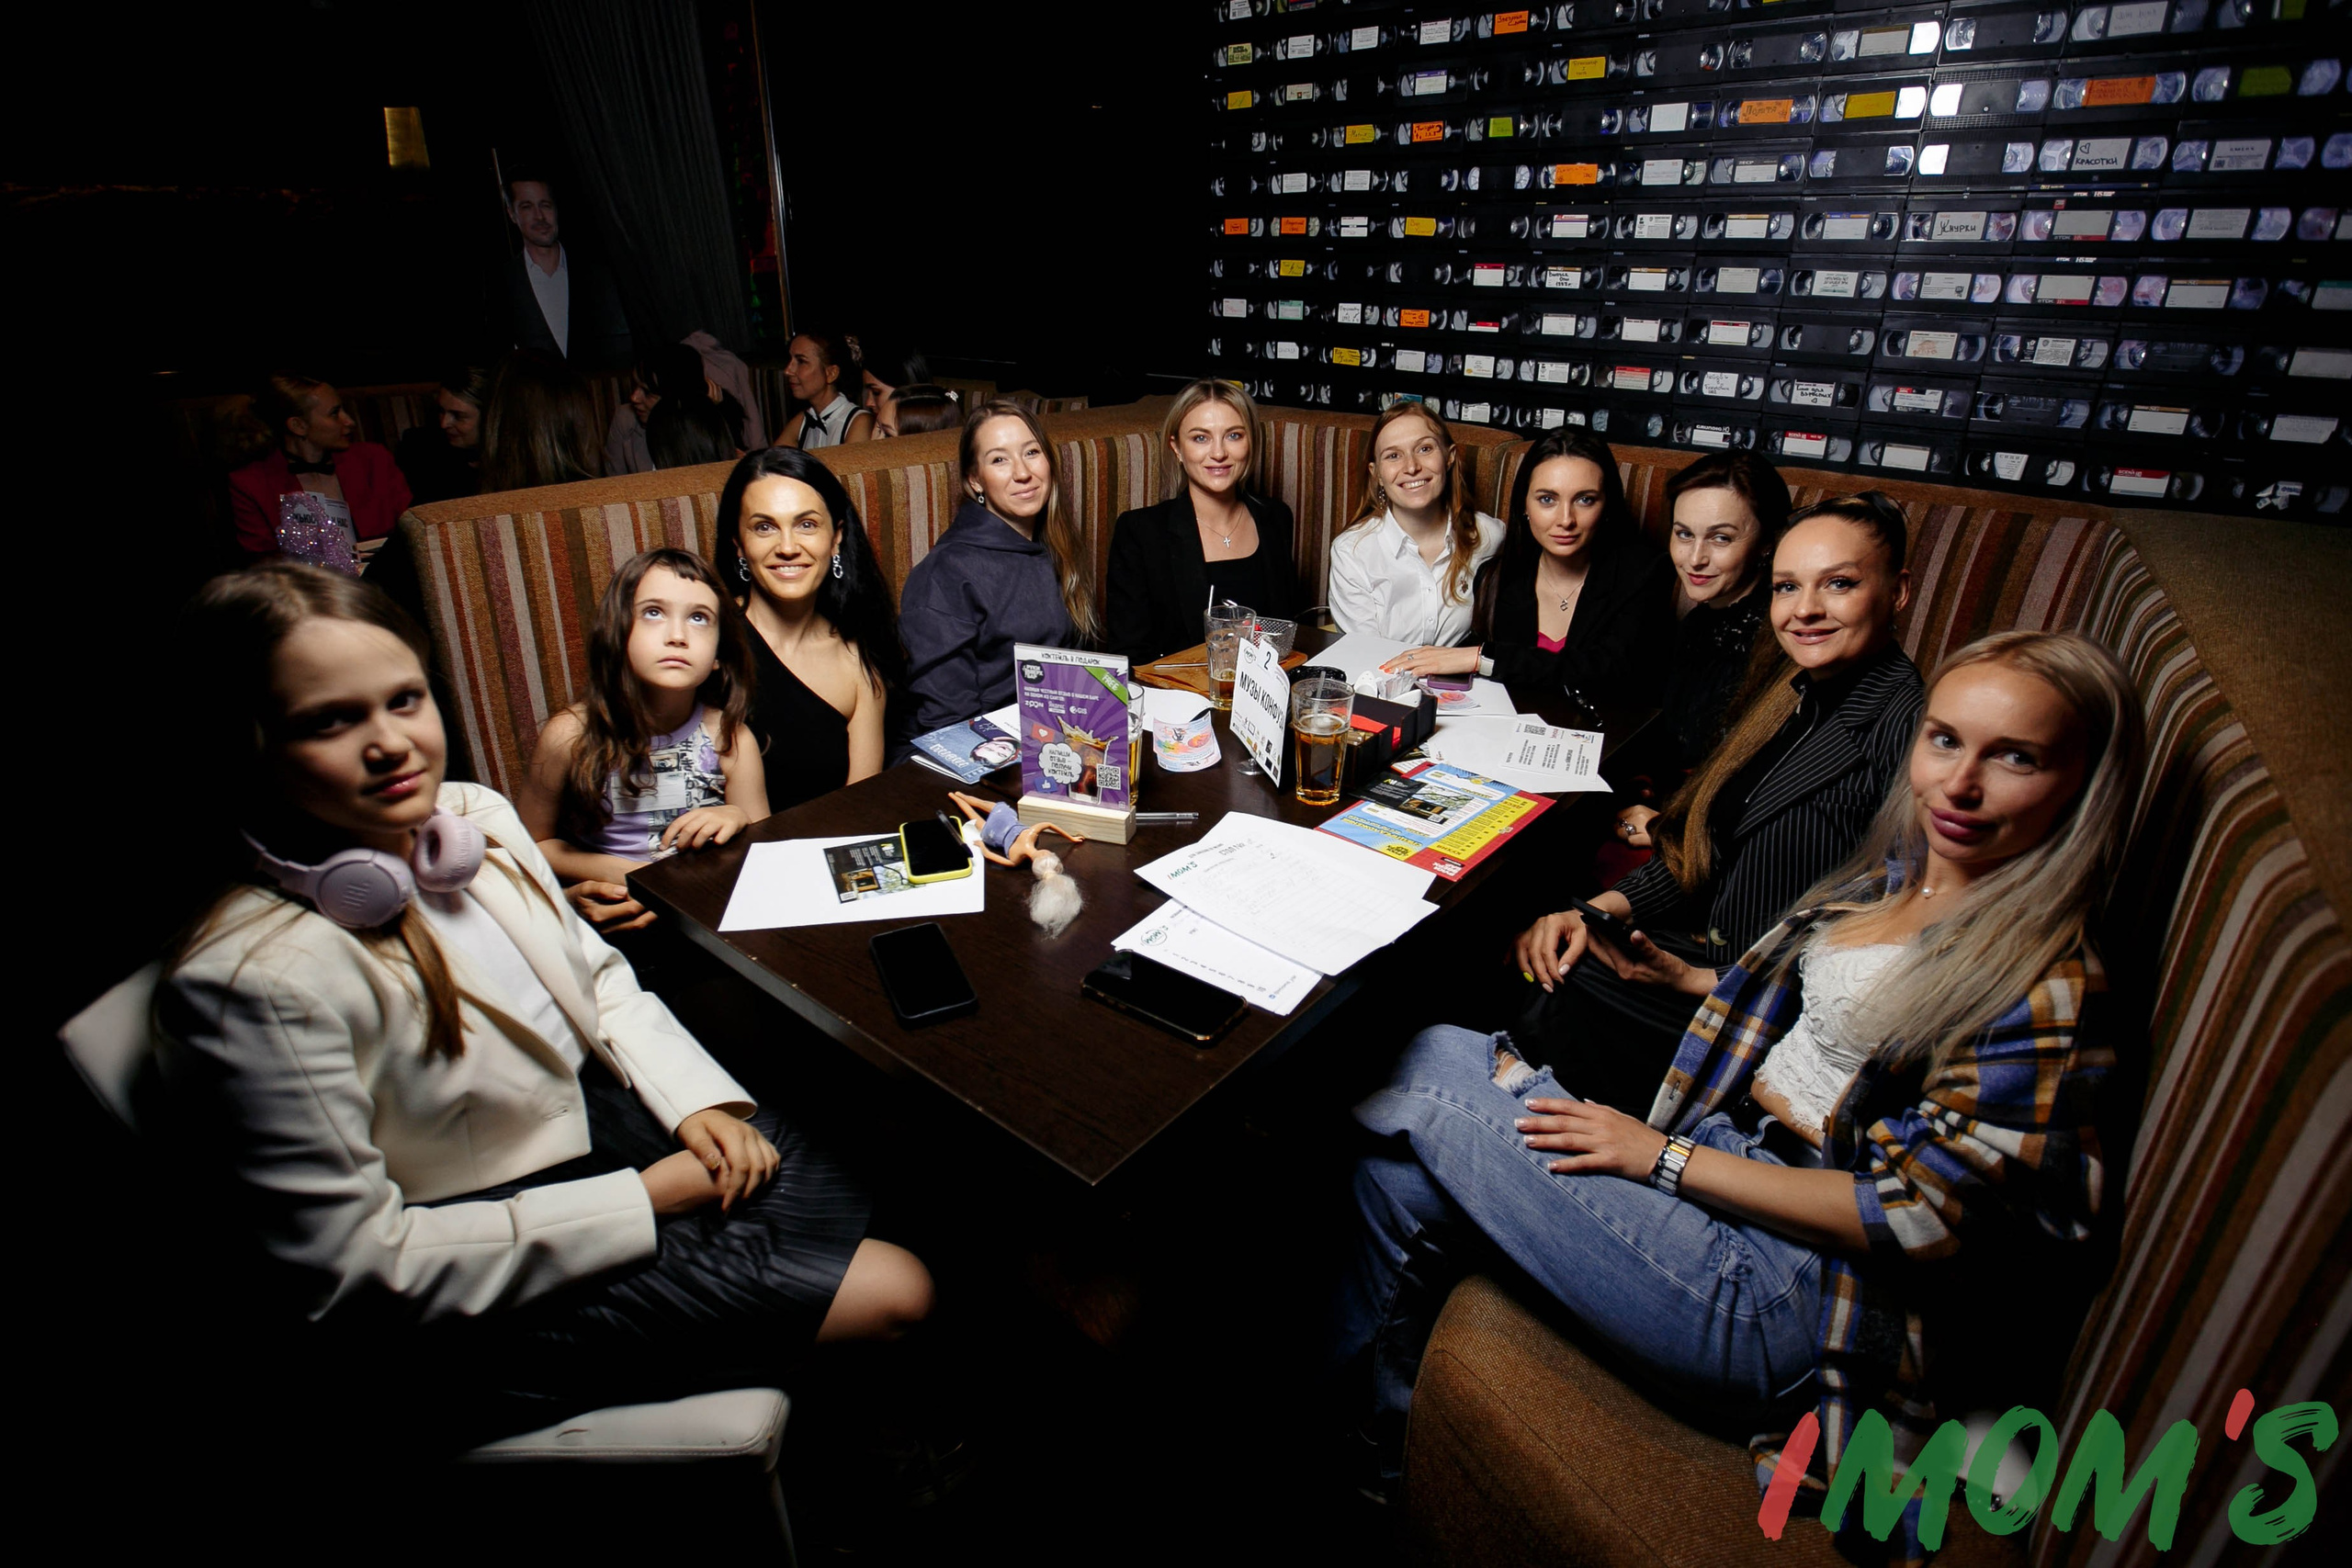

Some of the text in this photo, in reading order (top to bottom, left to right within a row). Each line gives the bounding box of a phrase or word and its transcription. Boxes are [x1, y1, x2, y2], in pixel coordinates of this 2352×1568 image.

[2075, 157, 2118, 166] КРАСОТКИ
[1041, 652, 1069, 662] КОКТЕЙЛЬ
[1075, 656, 1101, 666] ПОДАРОК
[1264, 651, 1272, 671] 2
[1102, 674, 1120, 691] FREE
[1239, 671, 1261, 704] МУЗЫ
[1436, 844, 1463, 856] КУХНЯ
